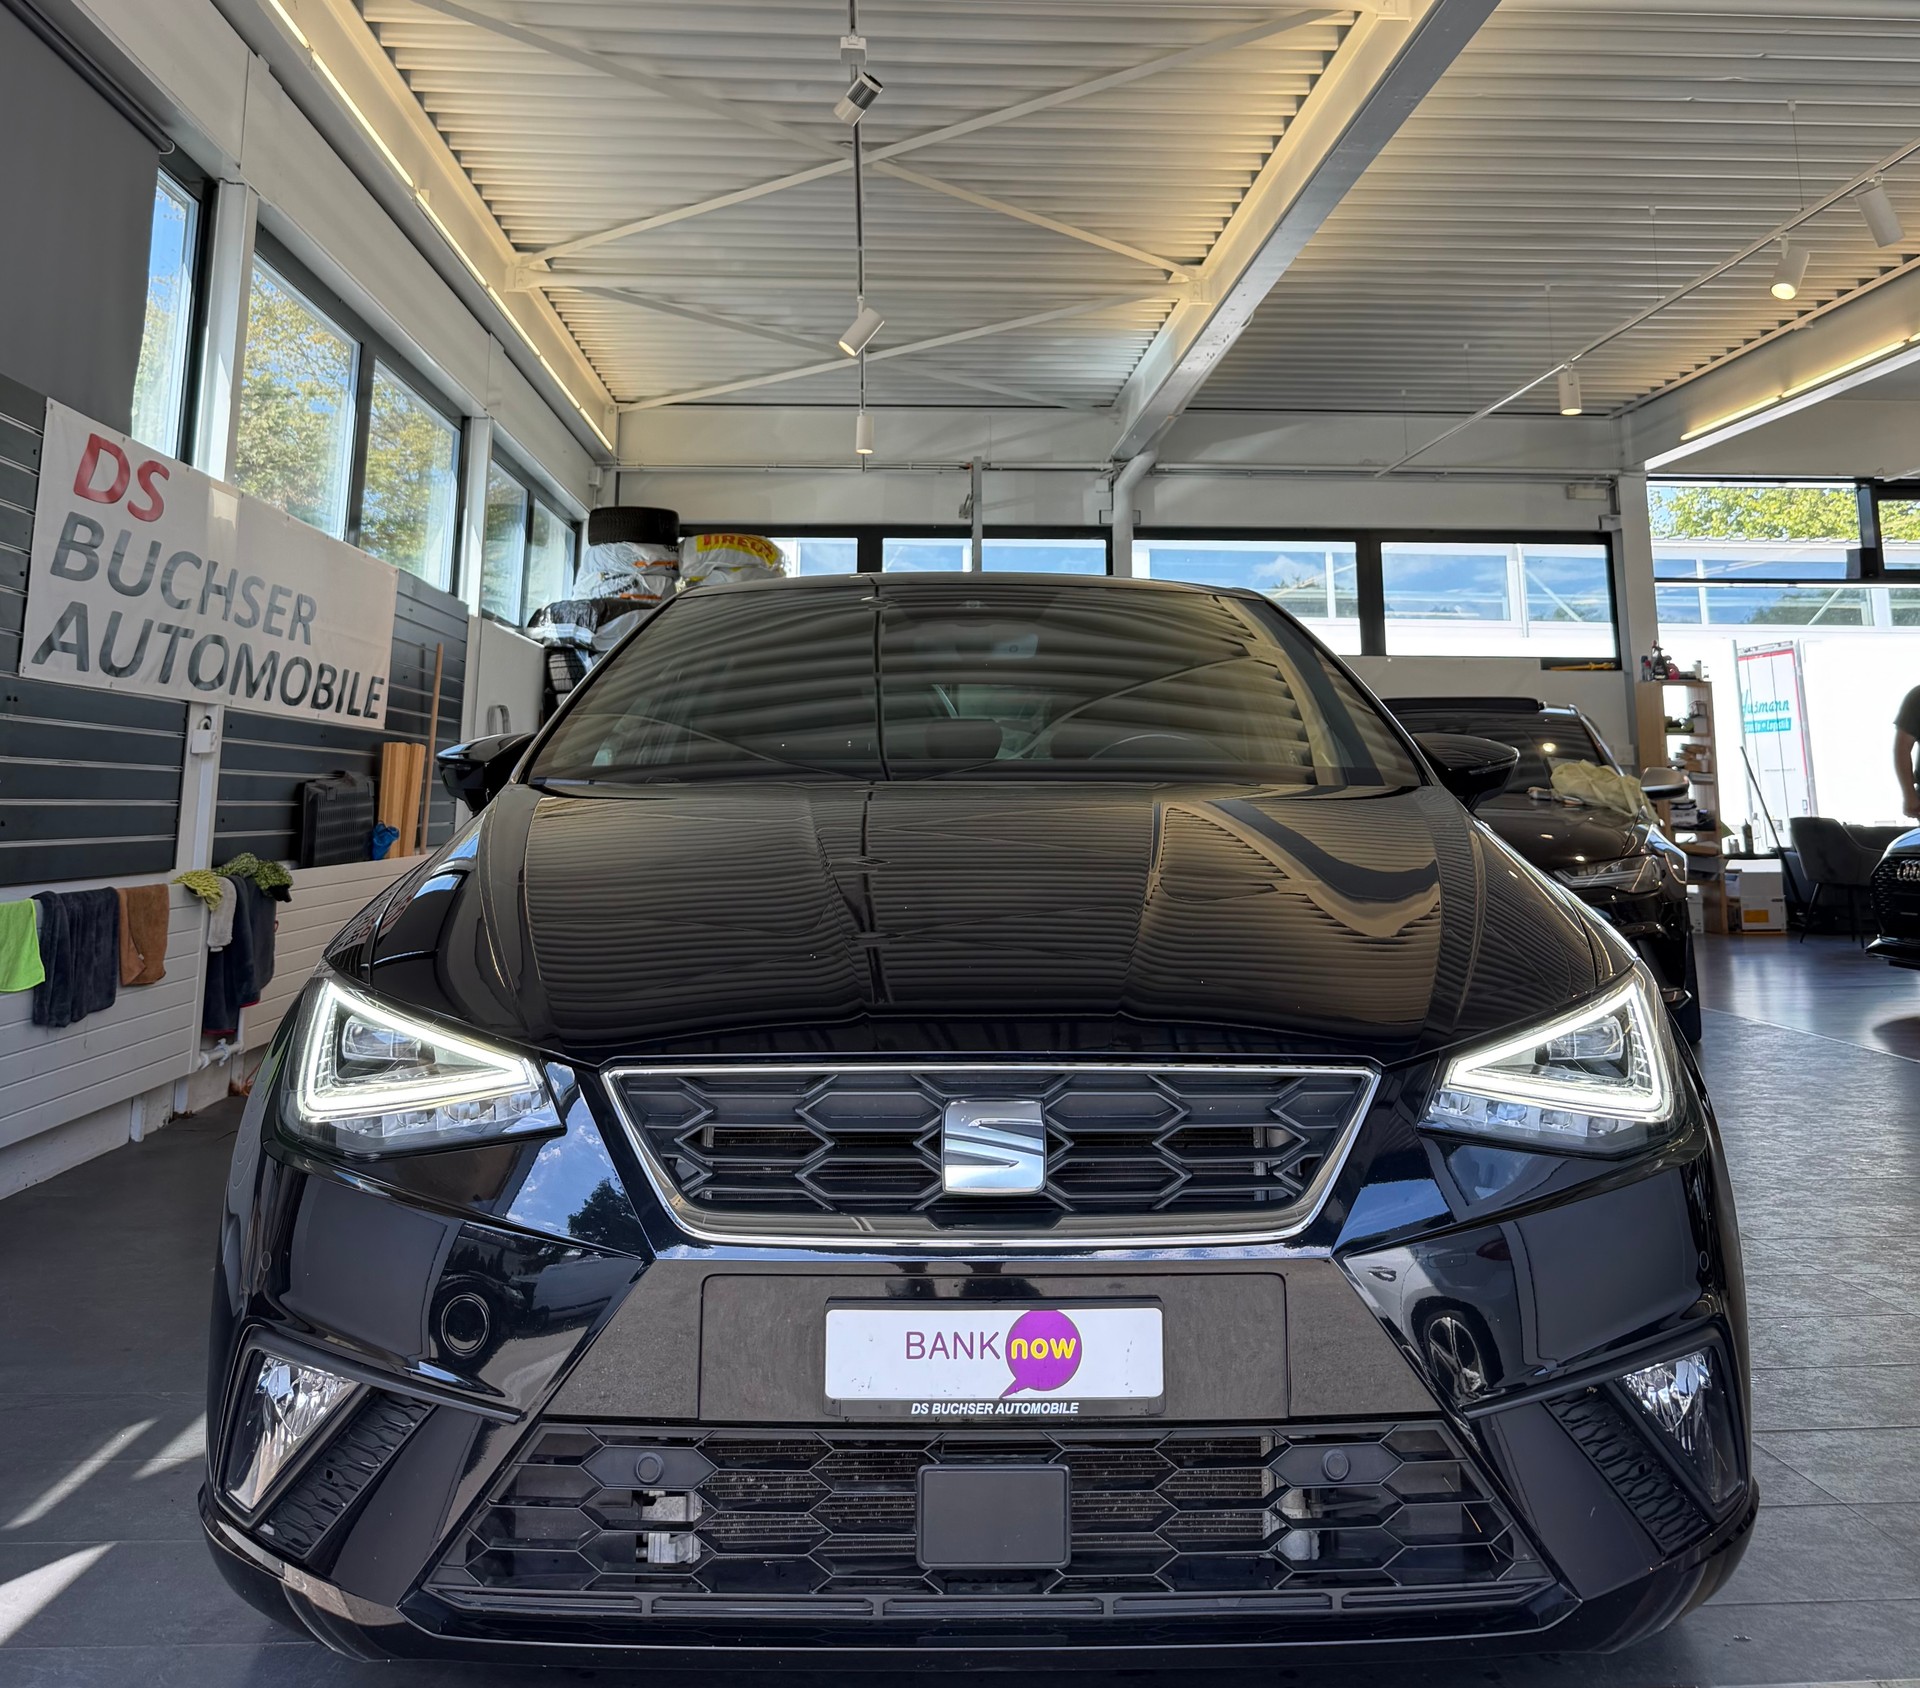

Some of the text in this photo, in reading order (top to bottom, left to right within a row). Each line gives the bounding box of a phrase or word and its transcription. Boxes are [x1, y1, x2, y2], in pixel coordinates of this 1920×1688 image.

[73, 432, 170, 523] DS
[49, 511, 318, 646] BUCHSER
[31, 600, 385, 720] AUTOMOBILE
[905, 1331, 1077, 1360] BANK now
[911, 1402, 1079, 1415] DS BUCHSER AUTOMOBILE
